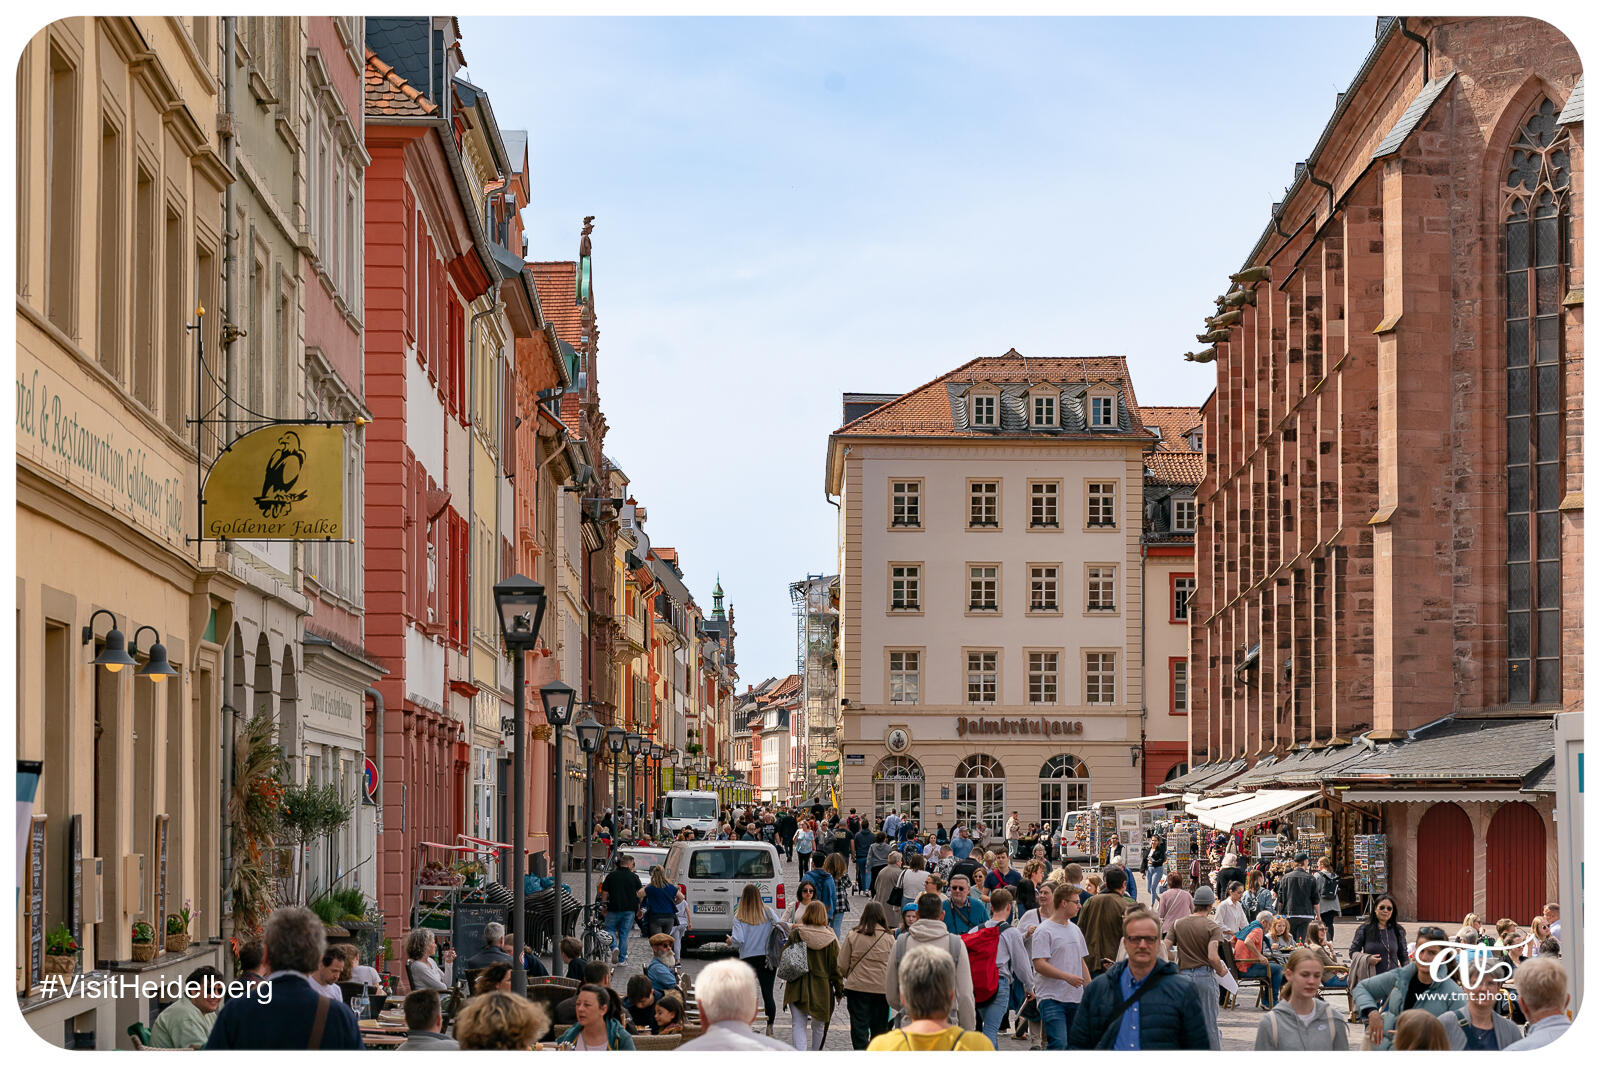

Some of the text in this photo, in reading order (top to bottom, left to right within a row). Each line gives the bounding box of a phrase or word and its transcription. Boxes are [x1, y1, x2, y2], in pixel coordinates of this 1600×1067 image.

[40, 385, 49, 447] &
[51, 395, 125, 494] Restauration
[126, 448, 163, 519] Goldener
[164, 478, 183, 535] Falke
[210, 518, 338, 536] Goldener Falke
[956, 716, 1084, 738] Palmbräuhaus
